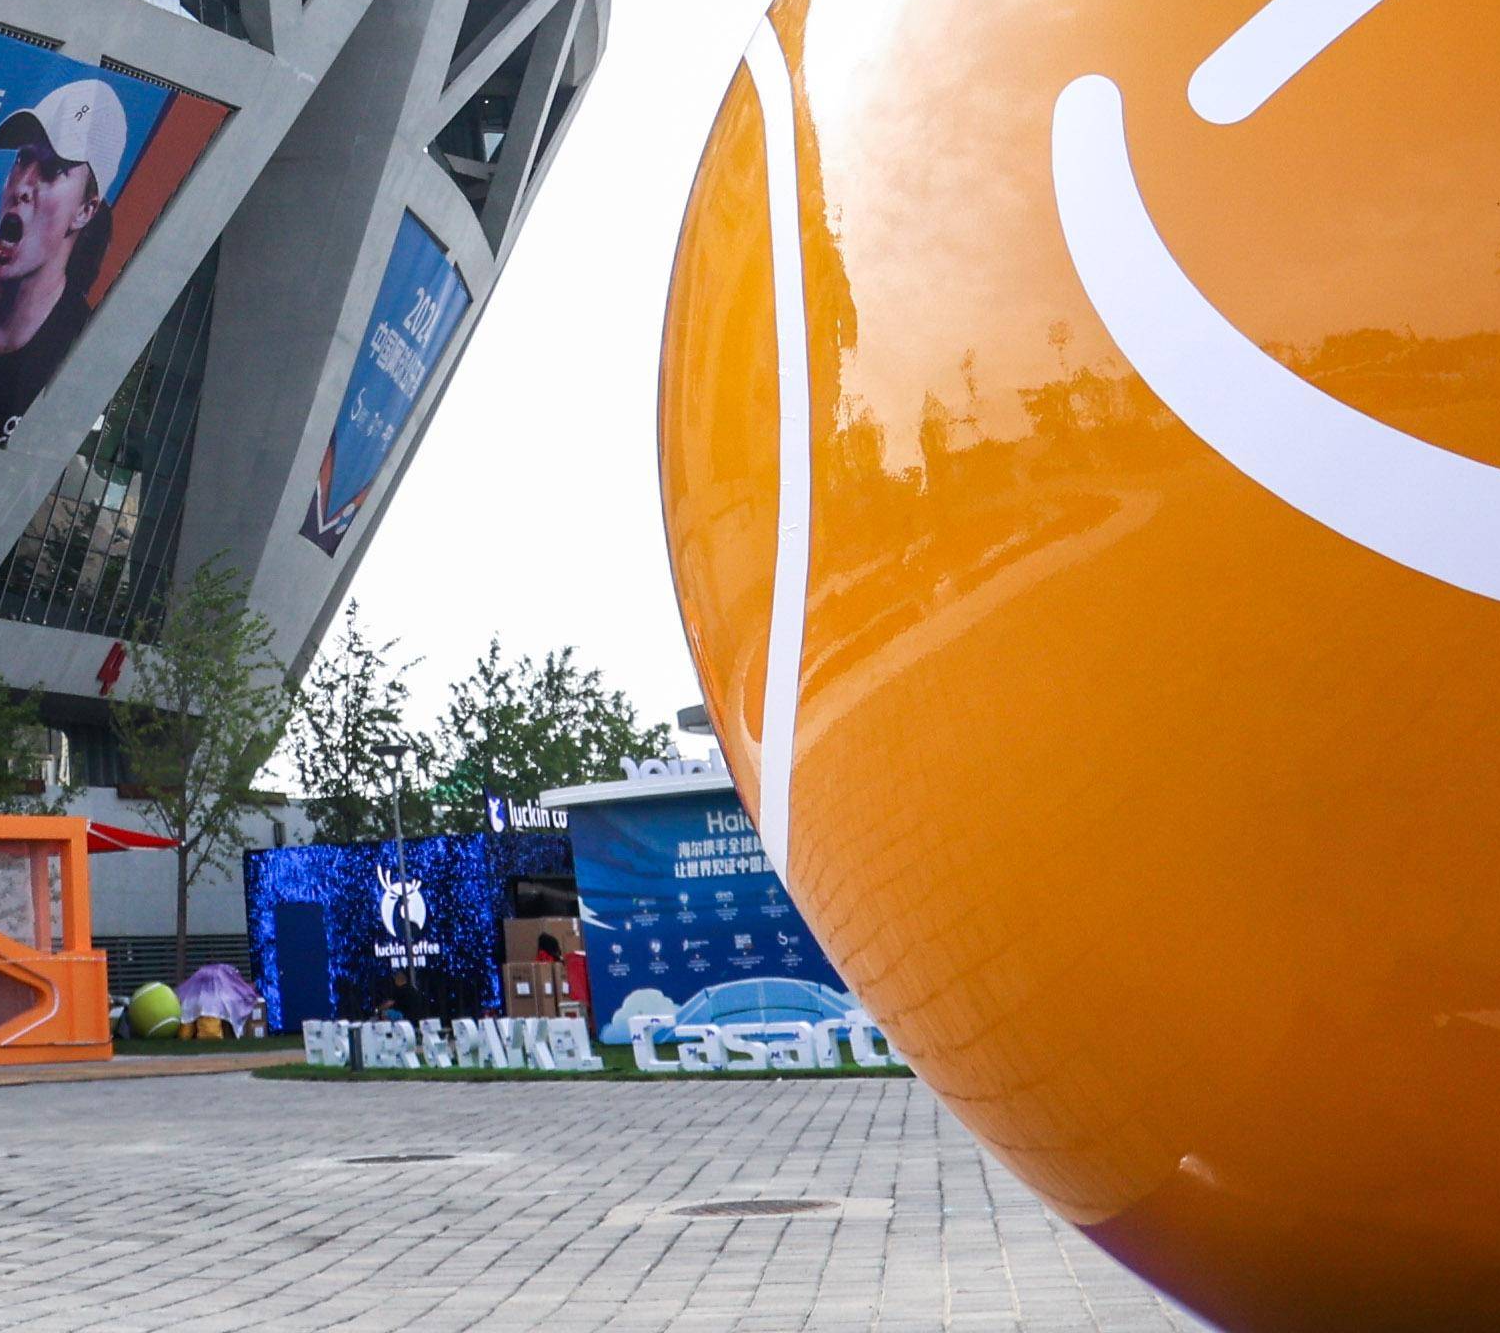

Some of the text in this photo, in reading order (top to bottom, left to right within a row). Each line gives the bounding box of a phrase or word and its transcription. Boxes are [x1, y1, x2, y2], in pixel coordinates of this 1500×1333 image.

[403, 287, 441, 349] 2024
[508, 798, 551, 828] luckin
[374, 939, 440, 958] luckin offee
